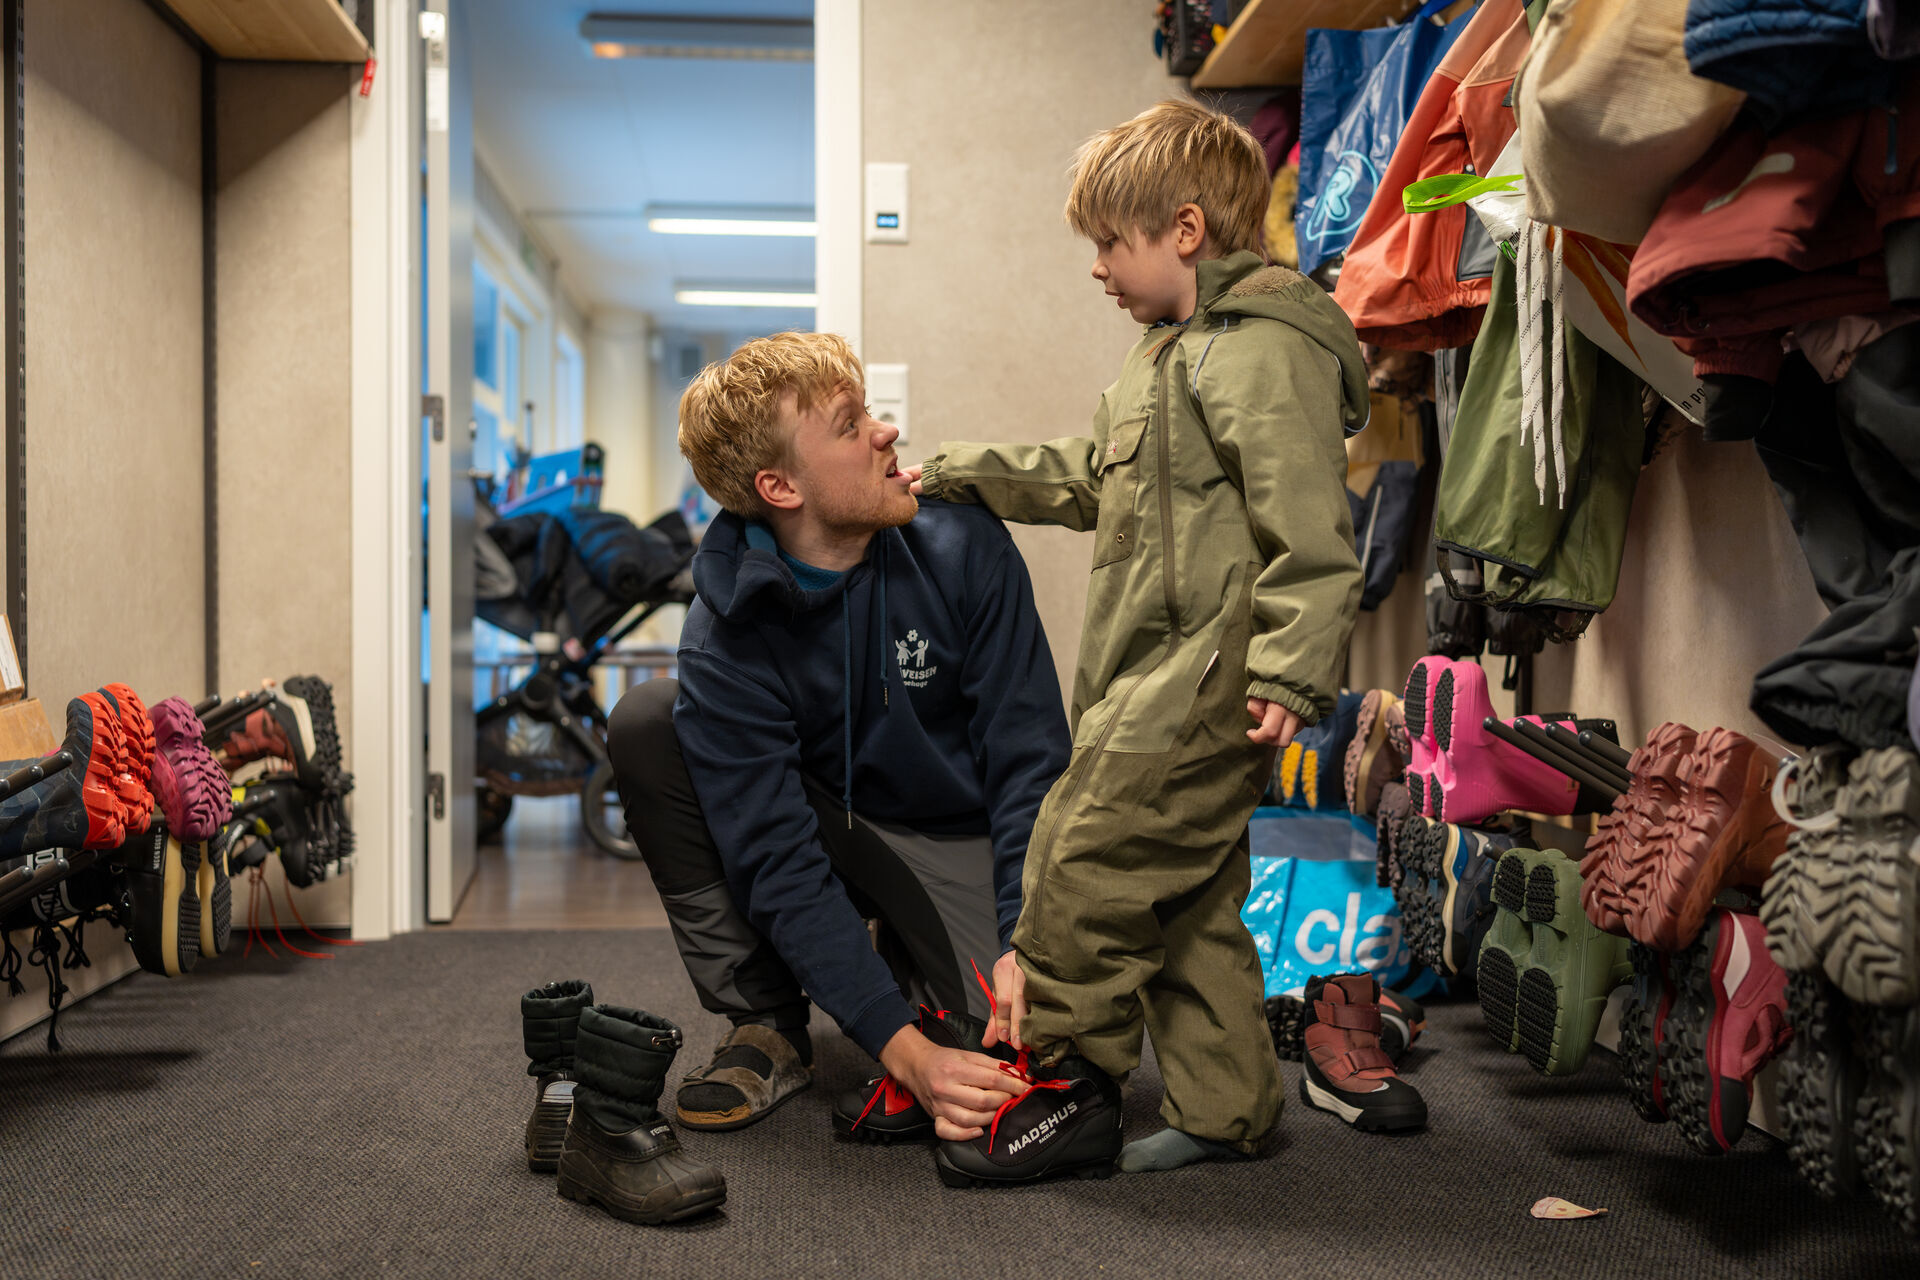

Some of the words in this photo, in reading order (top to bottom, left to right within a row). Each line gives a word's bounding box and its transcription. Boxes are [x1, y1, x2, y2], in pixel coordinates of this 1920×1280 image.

[900, 665, 937, 679] VEISEN
[1295, 892, 1412, 970] cla
[1008, 1101, 1078, 1155] MADSHUS
